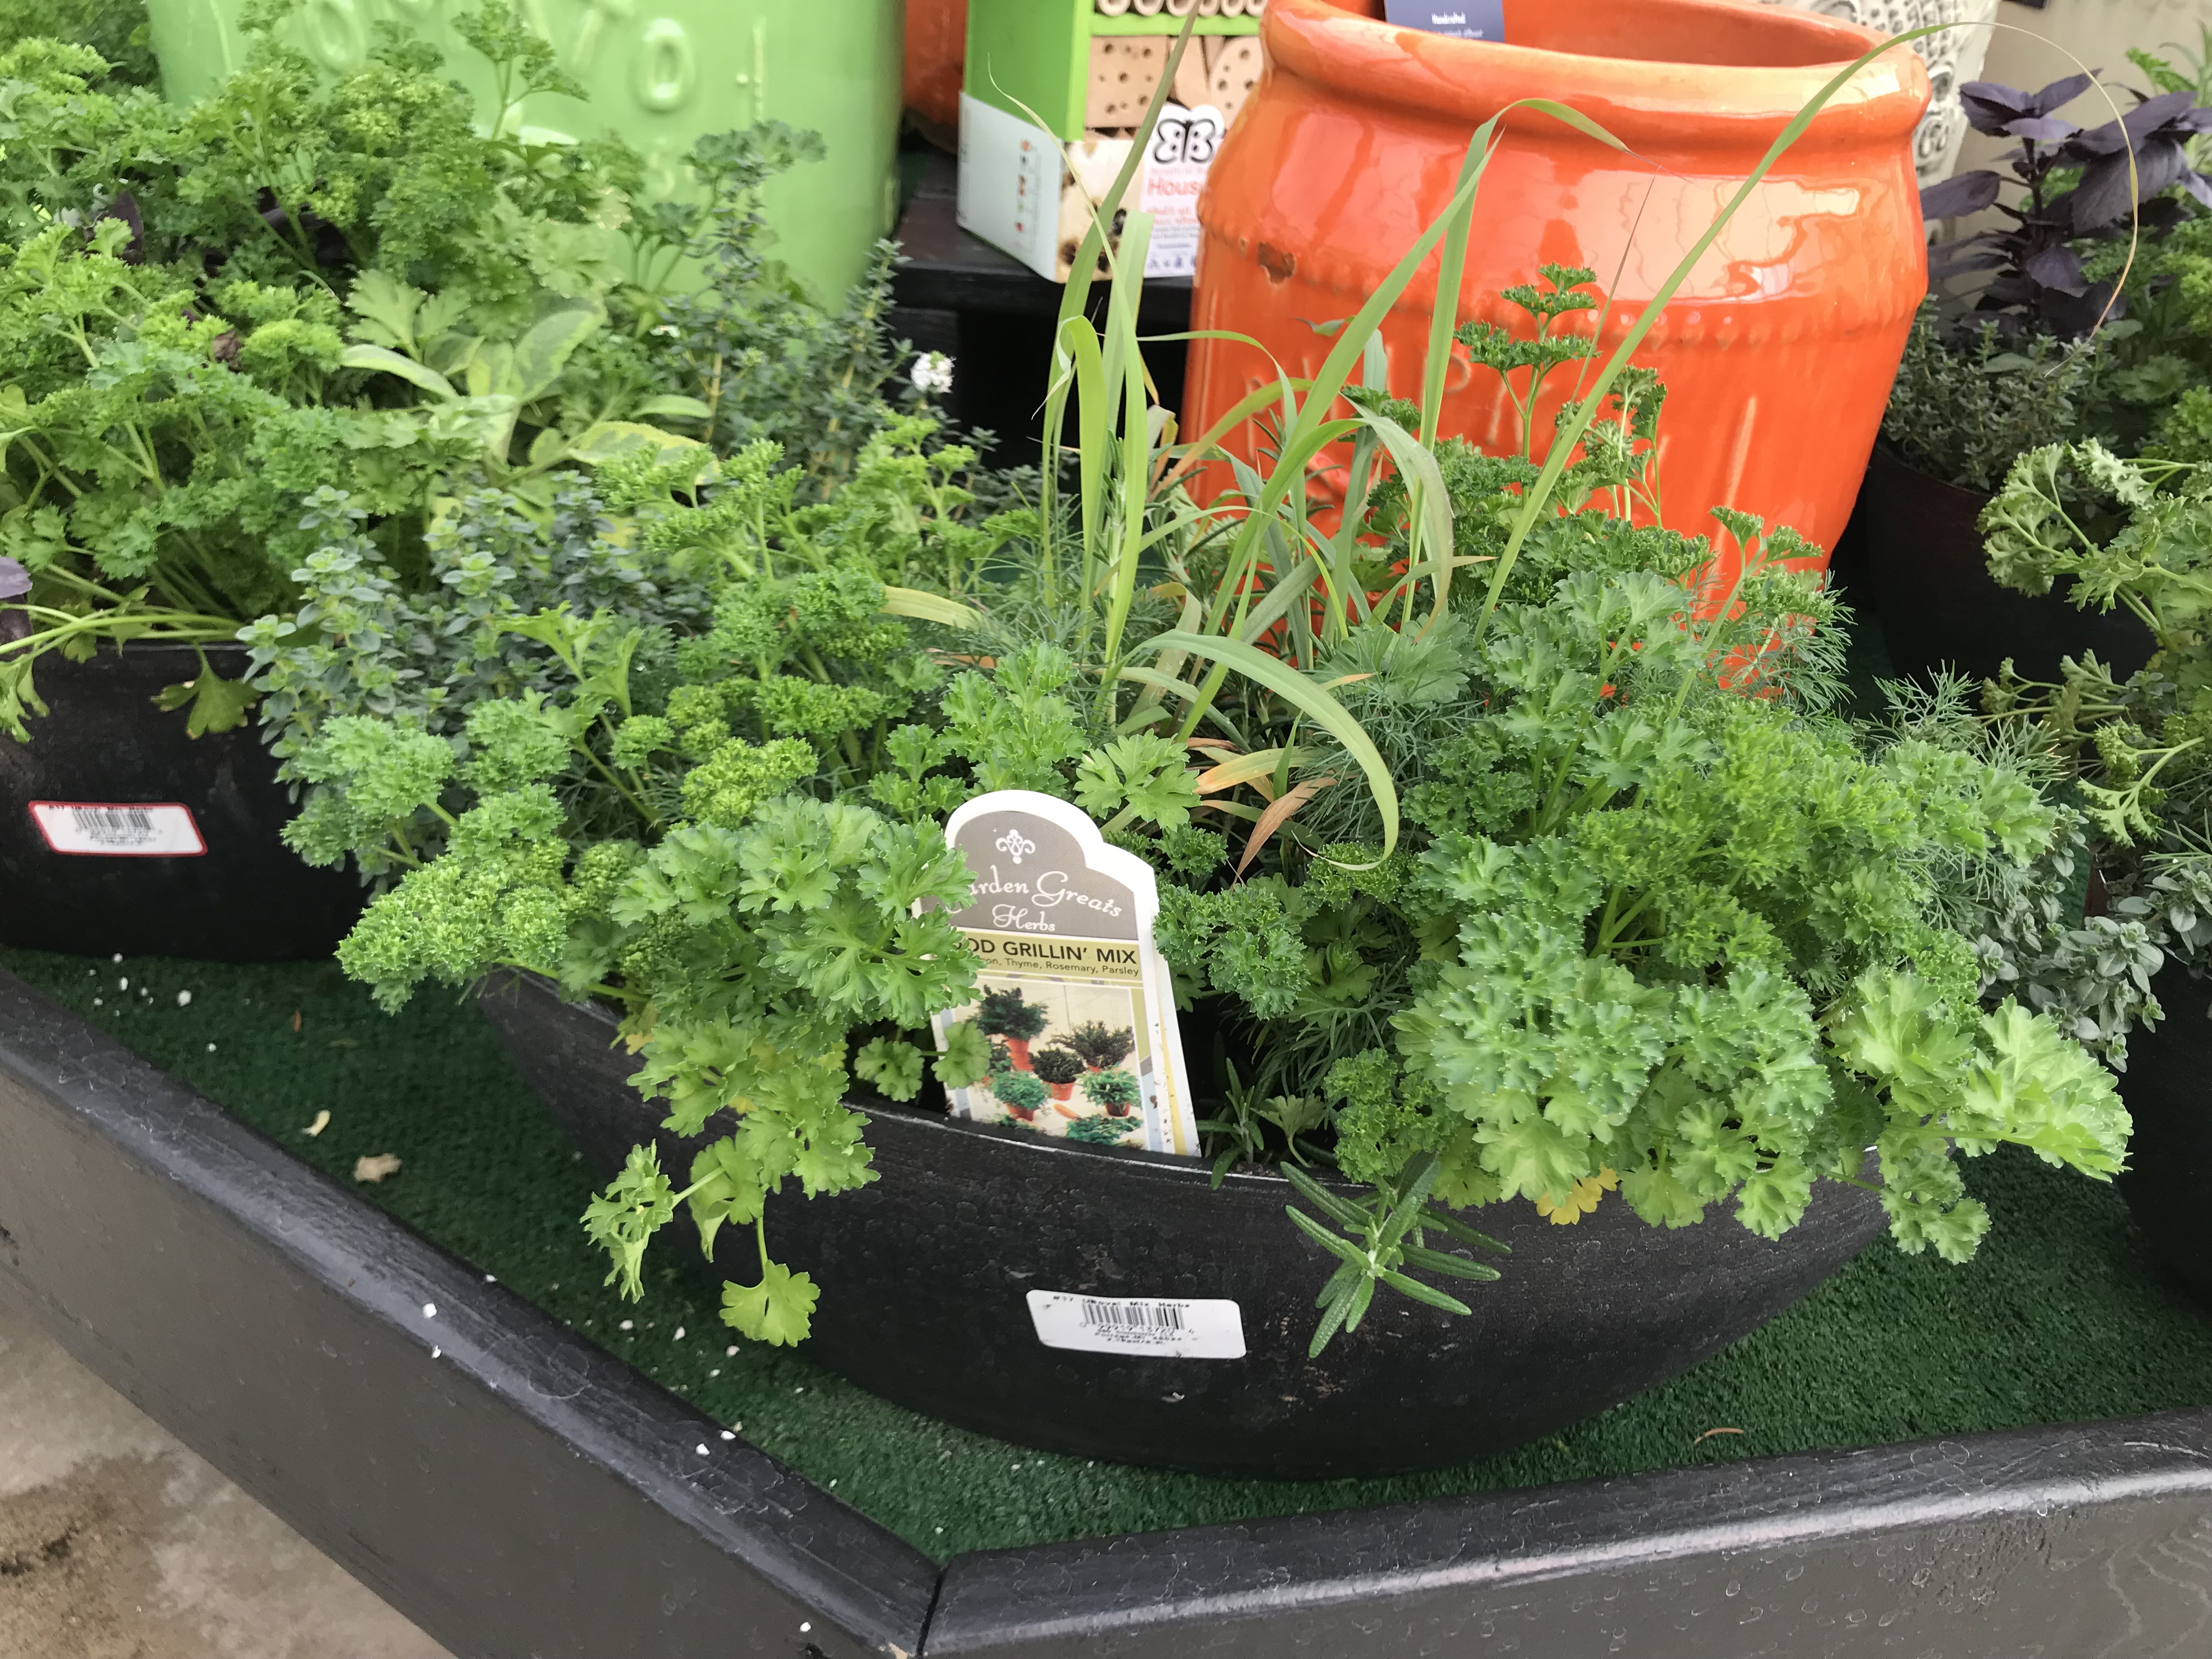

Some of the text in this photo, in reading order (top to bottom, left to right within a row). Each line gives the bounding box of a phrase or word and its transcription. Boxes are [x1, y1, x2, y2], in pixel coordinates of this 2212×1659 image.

[1031, 871, 1122, 917] Greats
[991, 904, 1056, 932] Herbs
[957, 938, 1137, 964] OD GRILLIN' MIX
[1005, 957, 1042, 969] Thyme,
[1045, 961, 1099, 974] Rosemary,
[1102, 965, 1139, 977] Parsley
